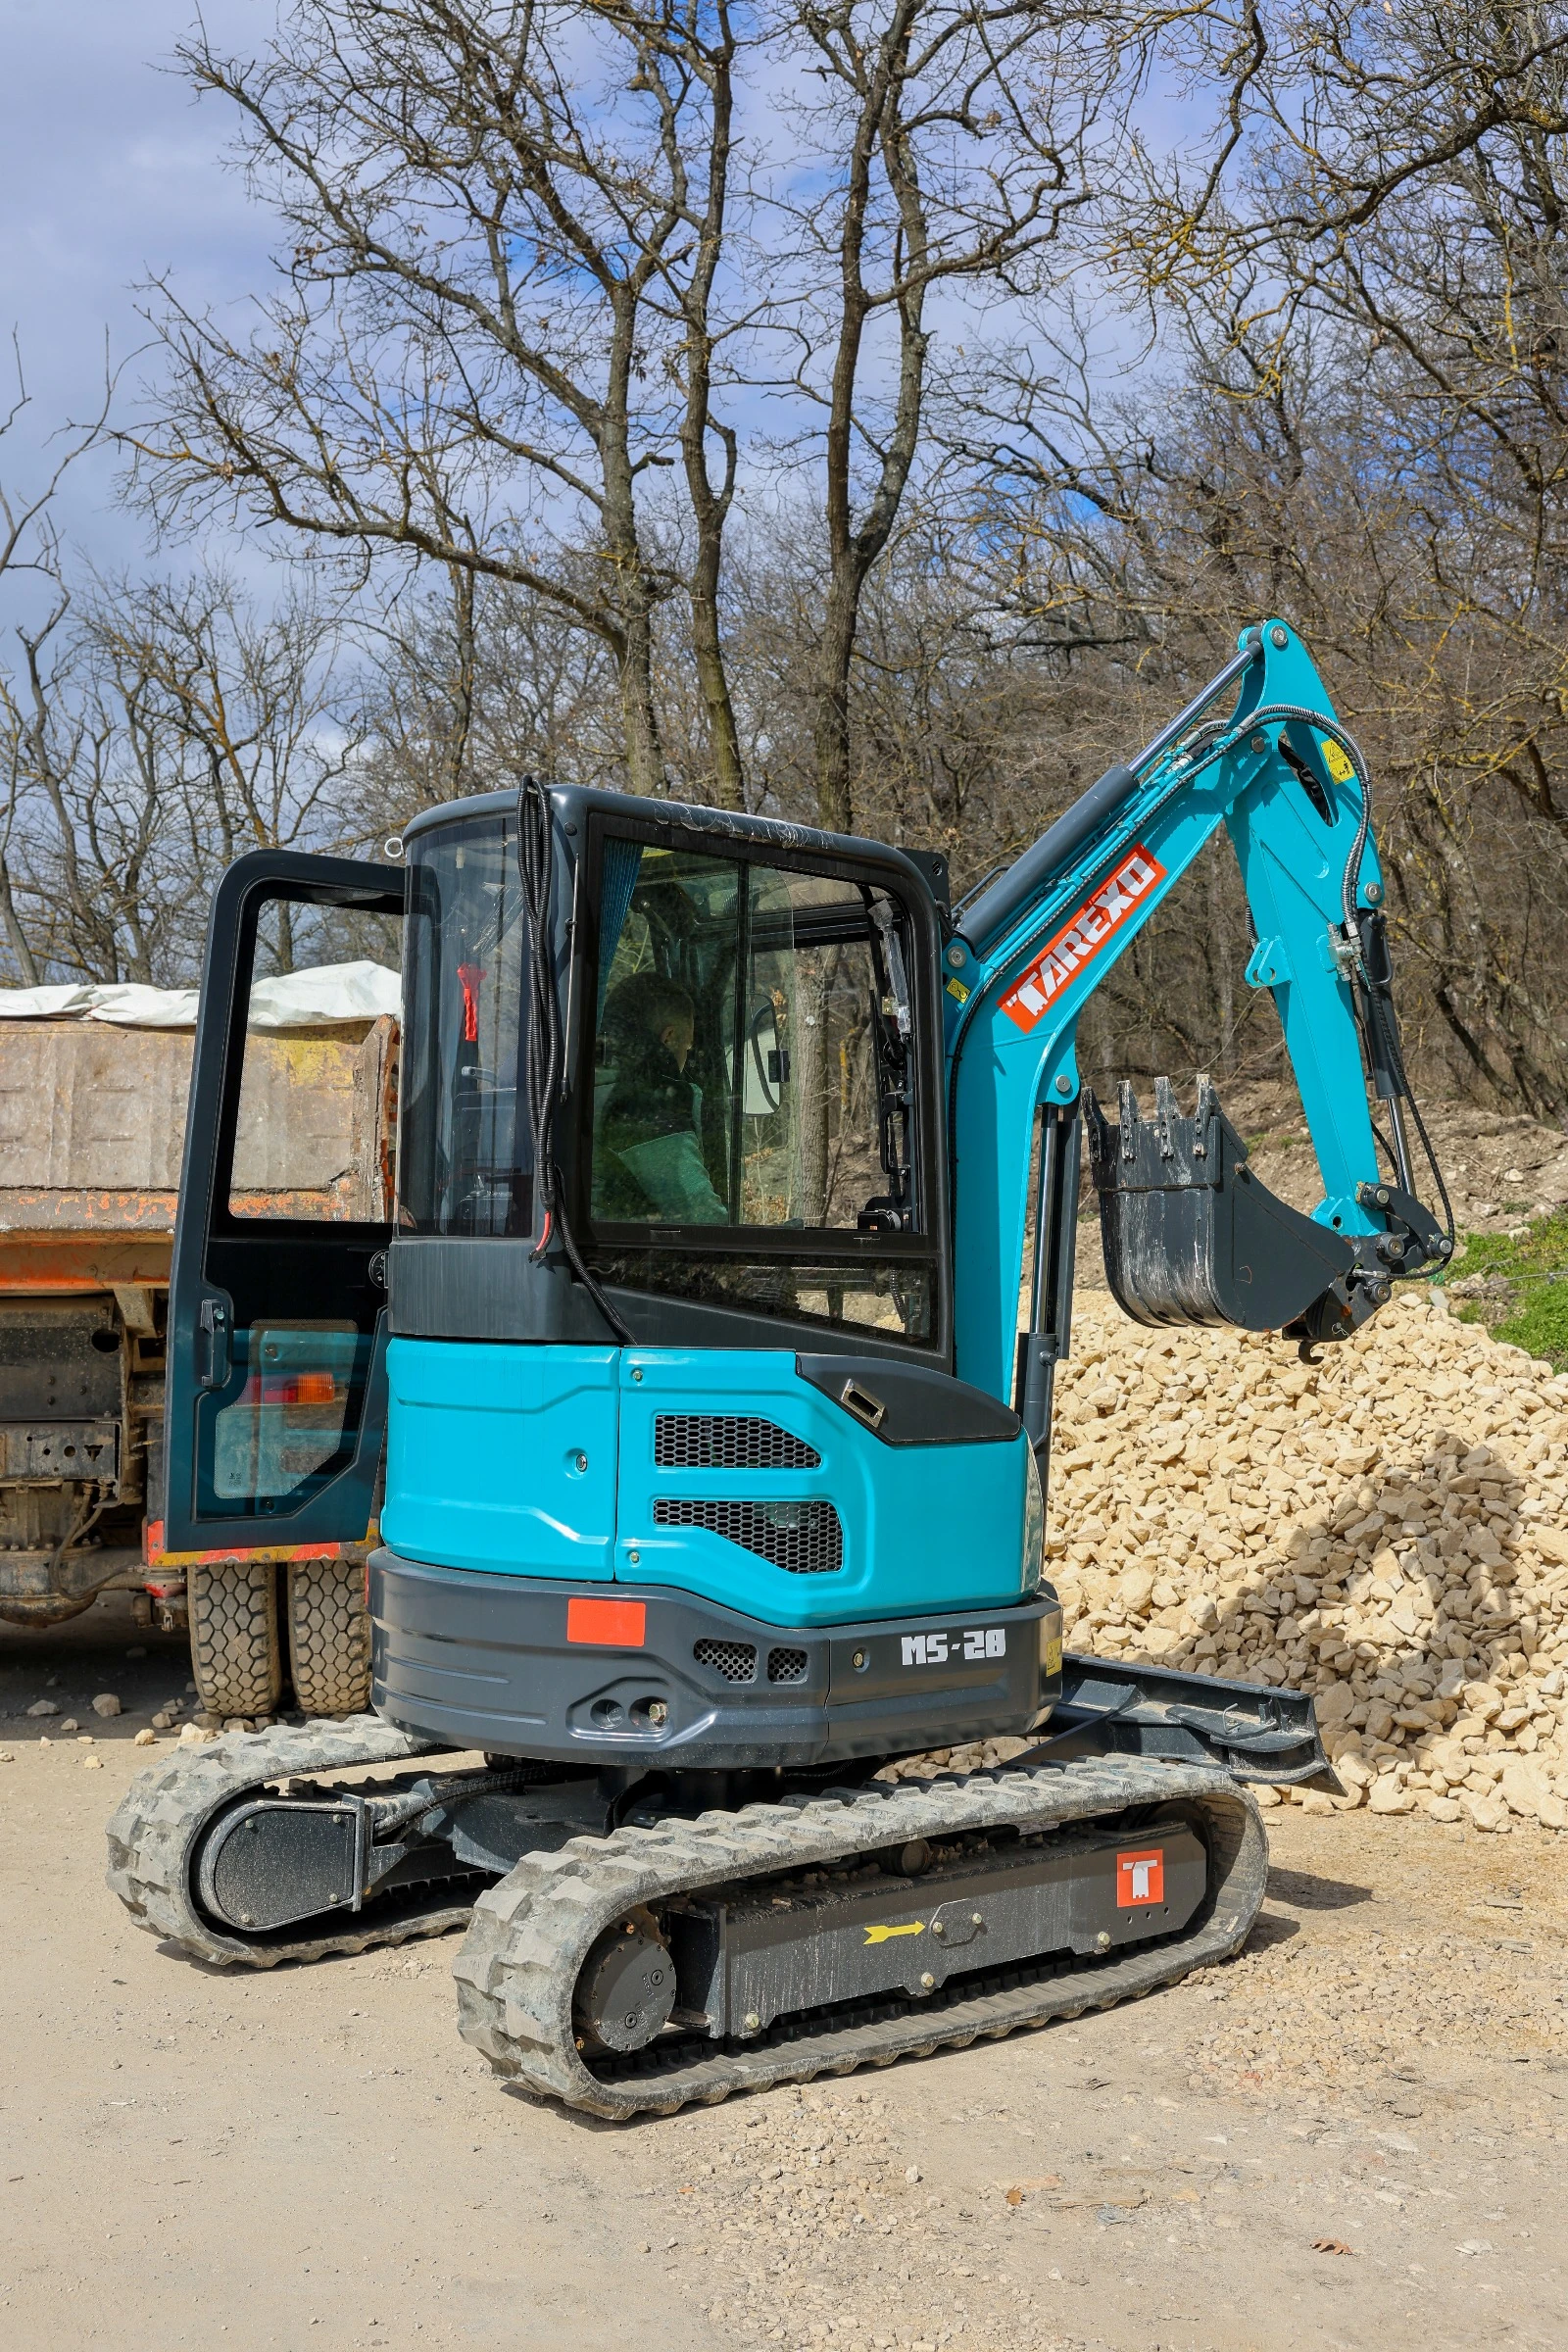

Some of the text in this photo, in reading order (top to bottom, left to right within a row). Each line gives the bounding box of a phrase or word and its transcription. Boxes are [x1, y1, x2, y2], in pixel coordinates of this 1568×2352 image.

[1006, 857, 1156, 1017] TAREXO
[901, 1628, 1006, 1666] MS-28
[1122, 1859, 1158, 1900] T
